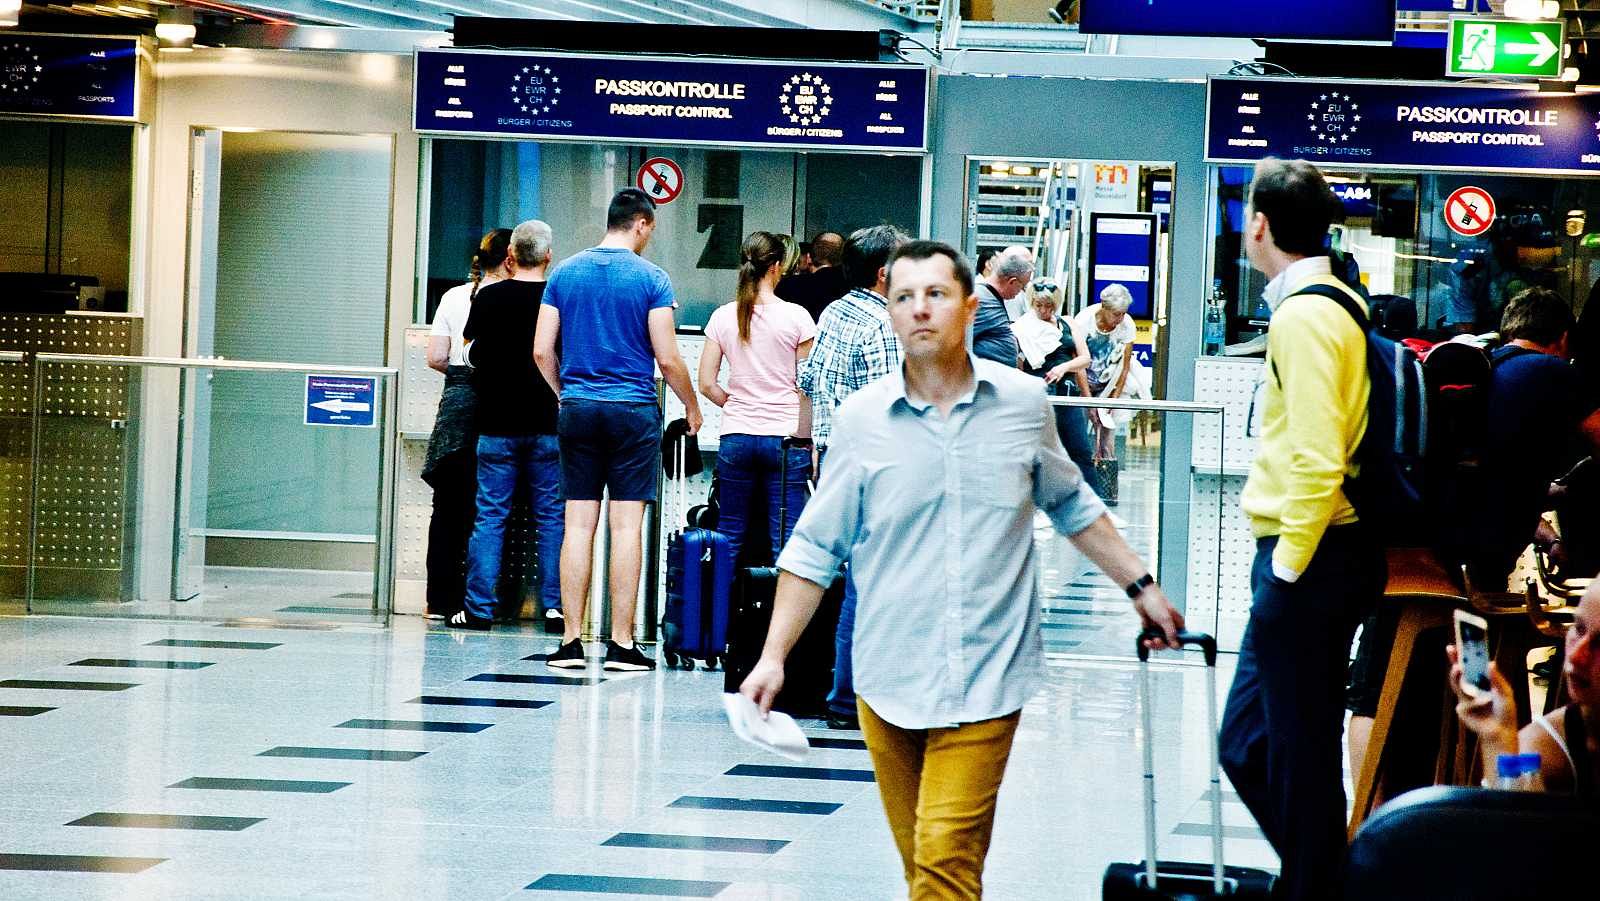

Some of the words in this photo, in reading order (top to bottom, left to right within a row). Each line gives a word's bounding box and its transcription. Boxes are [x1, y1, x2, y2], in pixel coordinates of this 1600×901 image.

[530, 76, 543, 85] EU
[525, 86, 547, 95] EWR
[595, 78, 746, 101] PASSKONTROLLE
[799, 85, 814, 95] EU
[77, 96, 116, 104] PASSPORTS
[529, 96, 543, 104] CH
[795, 94, 818, 105] EWR
[1240, 92, 1259, 101] ALLE
[609, 103, 674, 117] PASSPORT
[675, 105, 733, 119] CONTROL
[799, 105, 814, 115] CH
[1327, 103, 1342, 112] EU
[1322, 113, 1345, 122] EWR
[1396, 105, 1558, 127] PASSKONTROLLE
[536, 119, 573, 128] CITIZENS
[1326, 123, 1341, 132] CH
[767, 126, 801, 136] BÜRGER
[806, 129, 843, 138] CITIZENS
[1412, 131, 1481, 144] PASSPORT
[1481, 133, 1545, 146] CONTROL
[1335, 147, 1372, 156] CITIZENS
